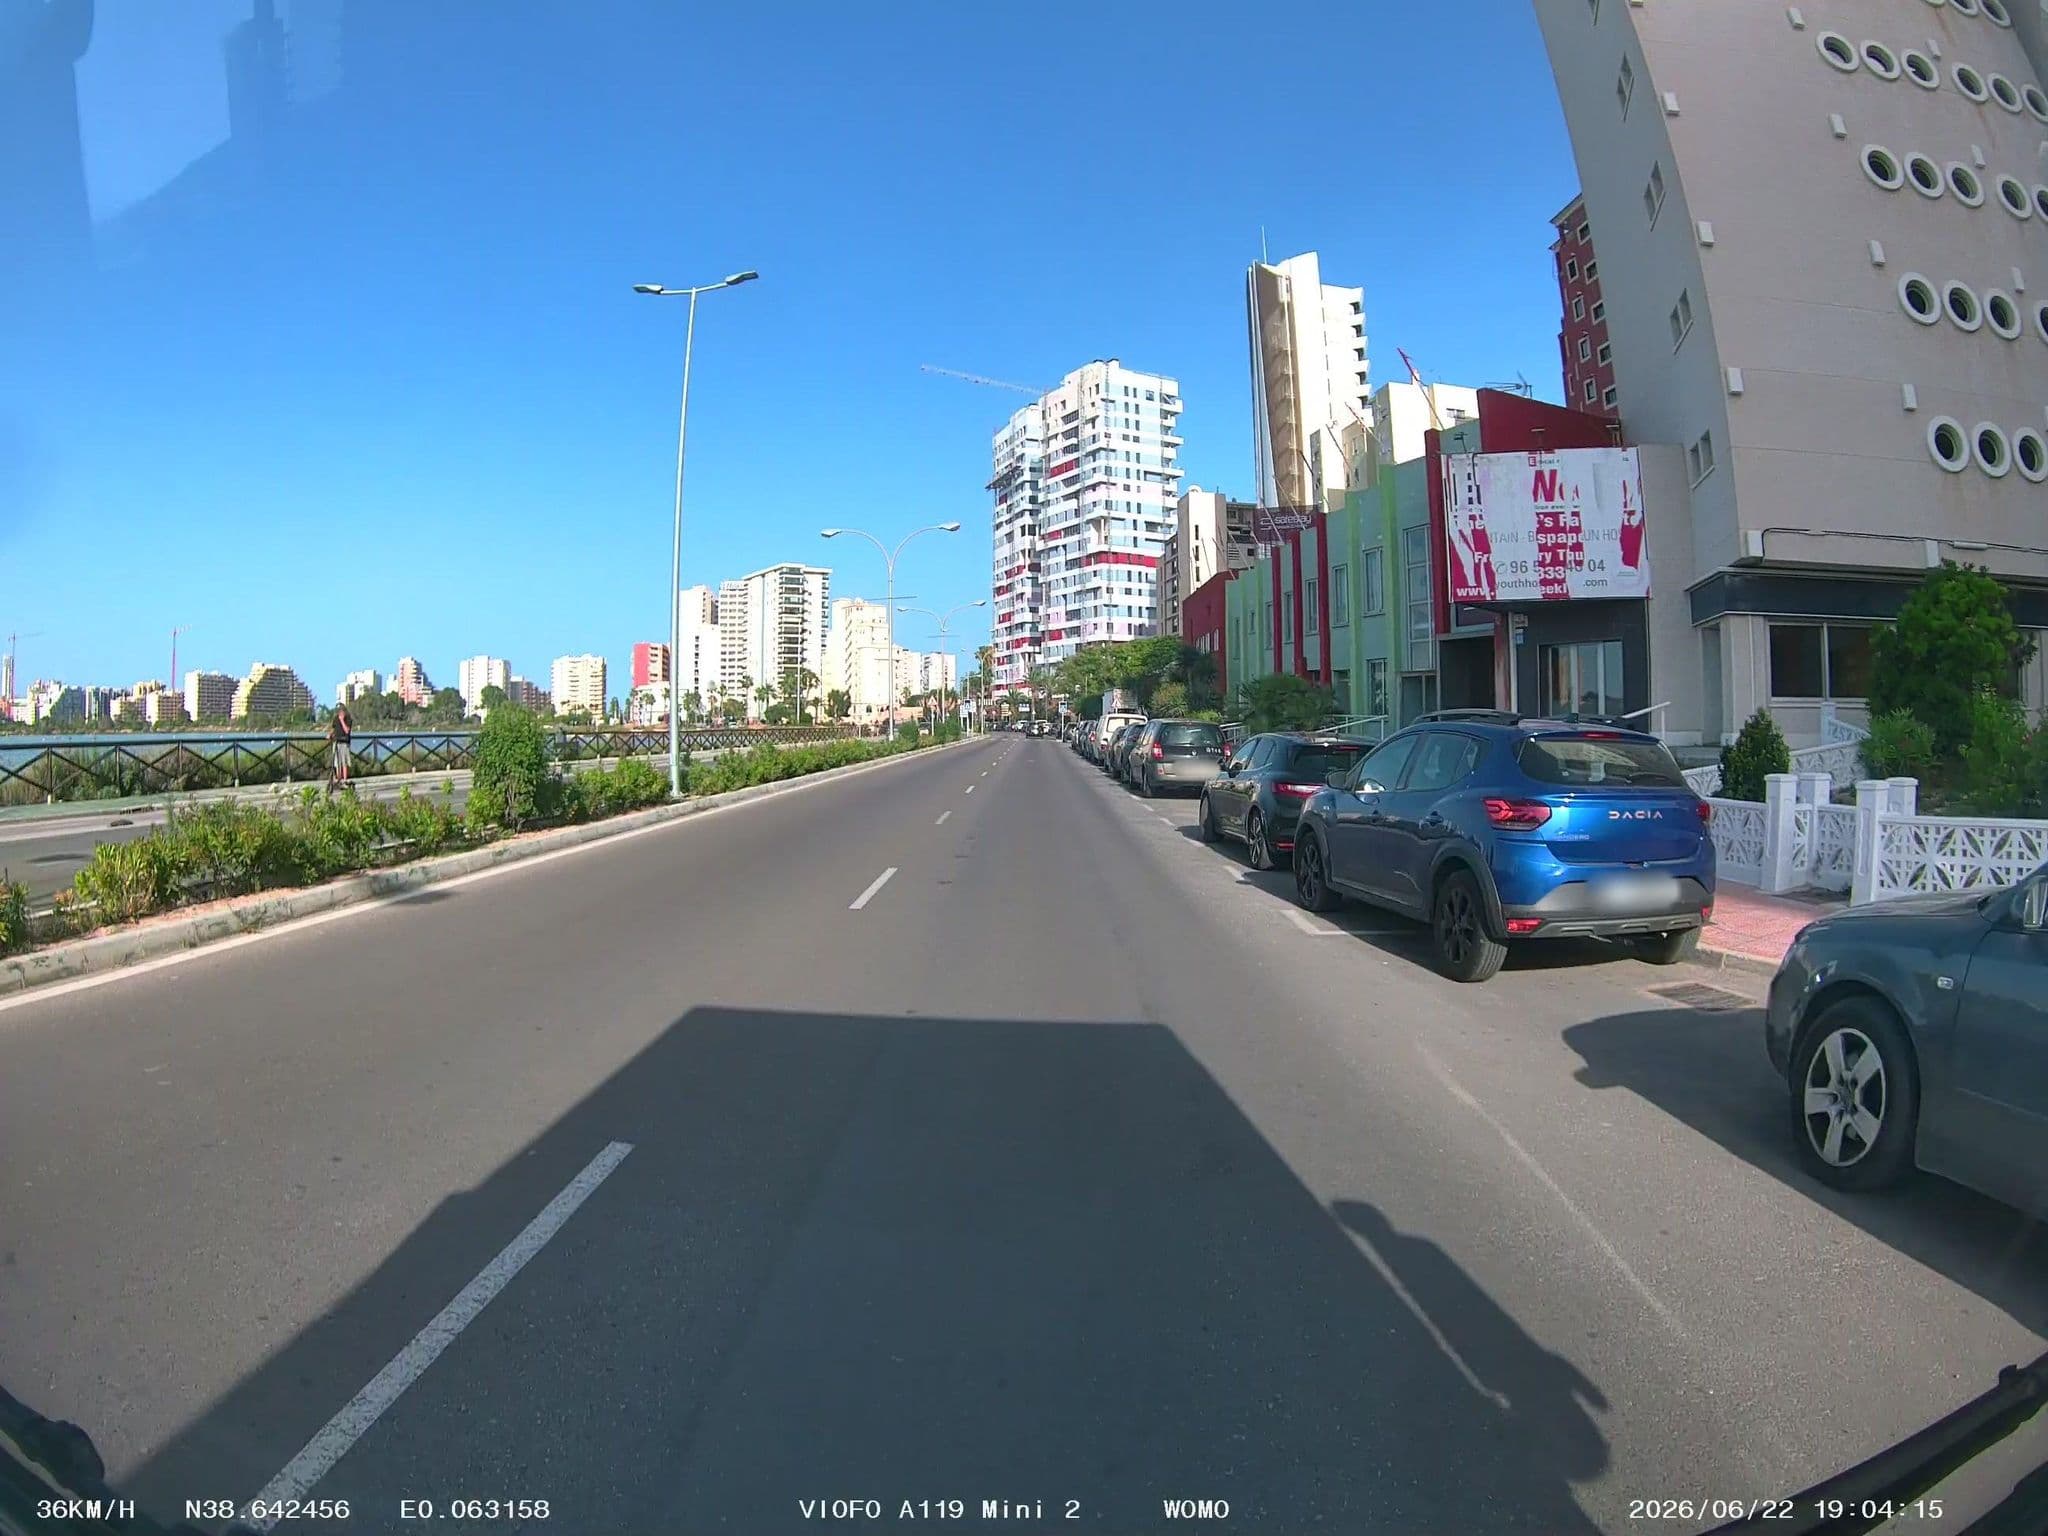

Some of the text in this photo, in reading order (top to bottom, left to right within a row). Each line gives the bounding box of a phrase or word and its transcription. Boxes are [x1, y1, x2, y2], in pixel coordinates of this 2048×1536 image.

[1510, 560, 1528, 574] 96
[1588, 558, 1605, 572] 04
[1608, 810, 1663, 820] DACIA
